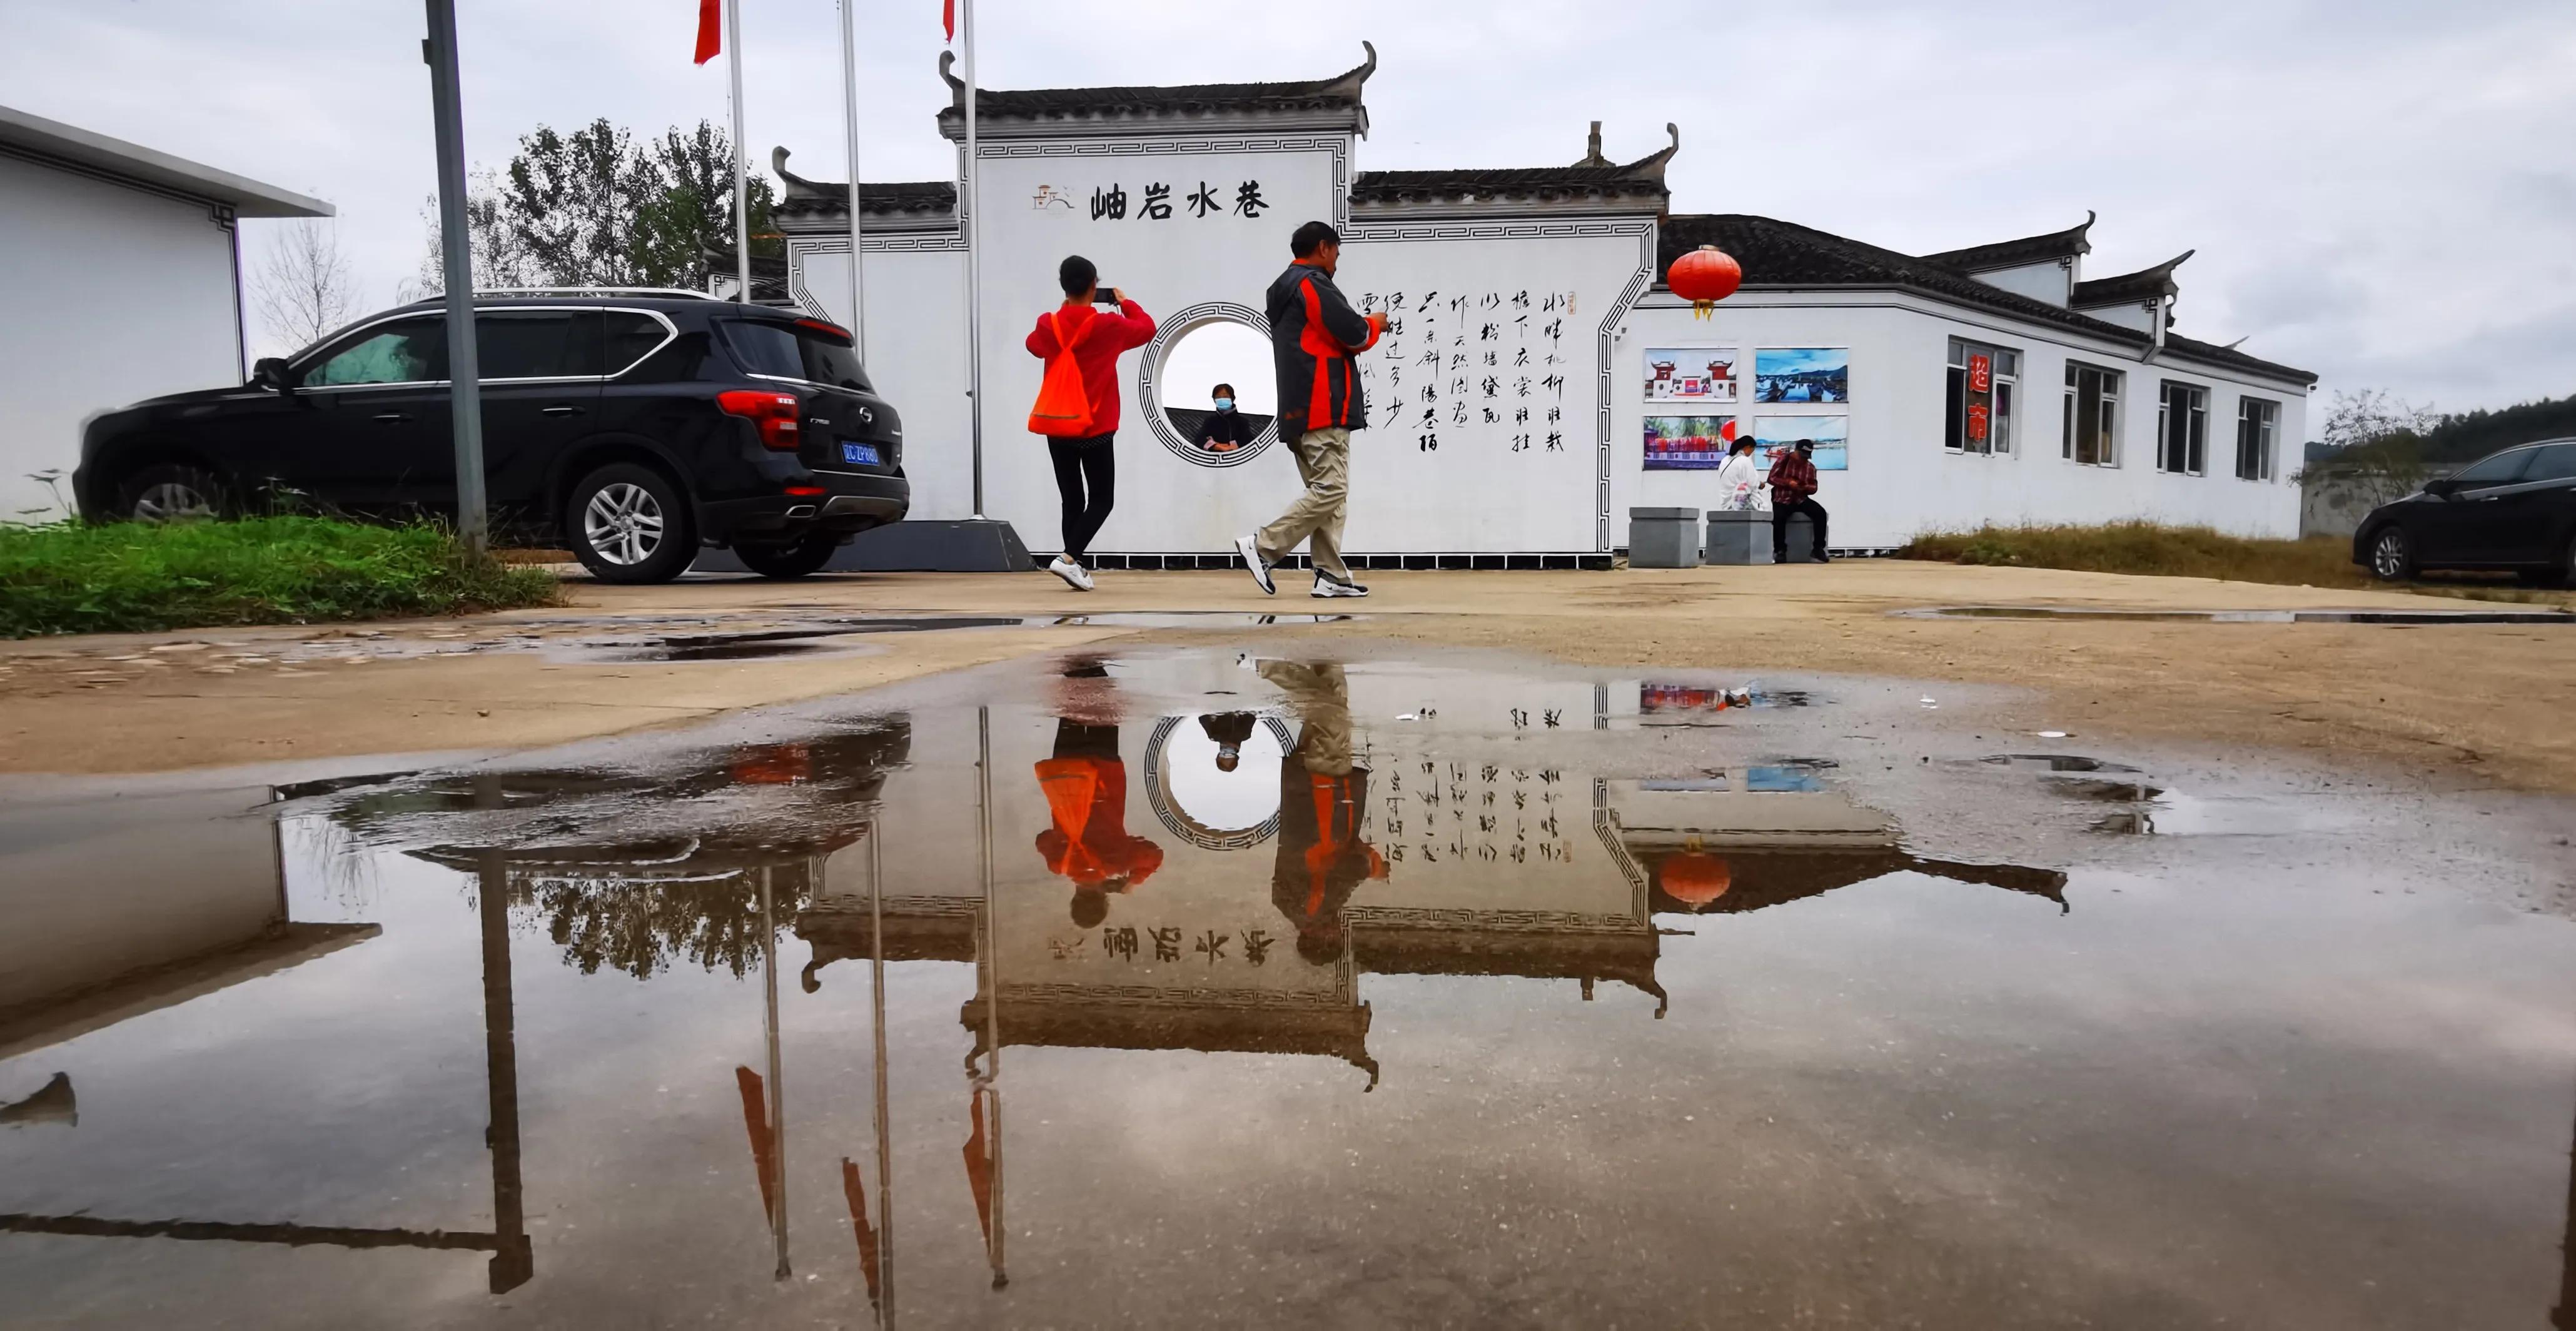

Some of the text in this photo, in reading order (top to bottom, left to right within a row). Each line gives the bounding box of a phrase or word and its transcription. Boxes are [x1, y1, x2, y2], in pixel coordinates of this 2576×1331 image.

[1091, 180, 1270, 221] 岫岩水巷
[1967, 354, 1989, 442] 超市
